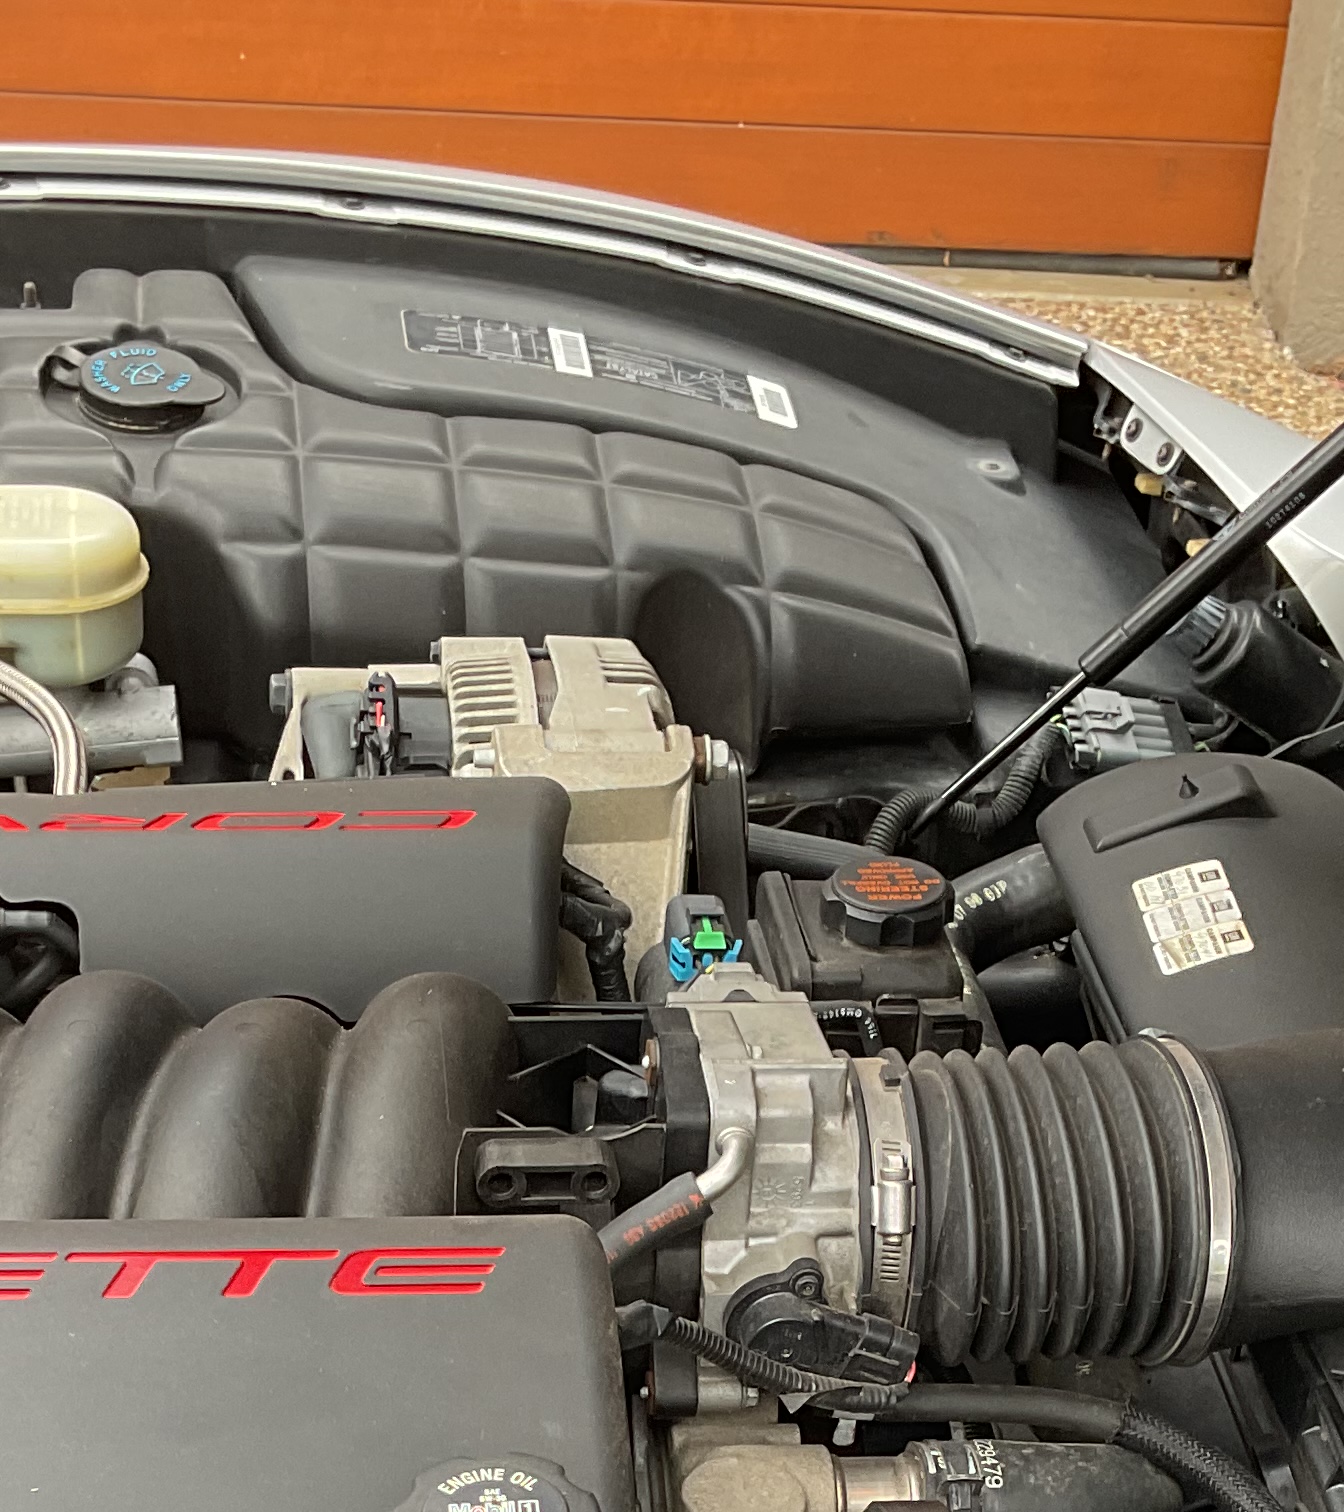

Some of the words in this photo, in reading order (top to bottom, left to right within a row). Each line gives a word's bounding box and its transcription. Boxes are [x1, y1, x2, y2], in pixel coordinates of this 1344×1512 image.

[109, 348, 157, 359] FLUID
[166, 372, 192, 392] ONLY
[855, 884, 929, 893] STEERING
[867, 893, 922, 901] POWER
[437, 1468, 506, 1495] ENGINE
[510, 1471, 538, 1492] OIL
